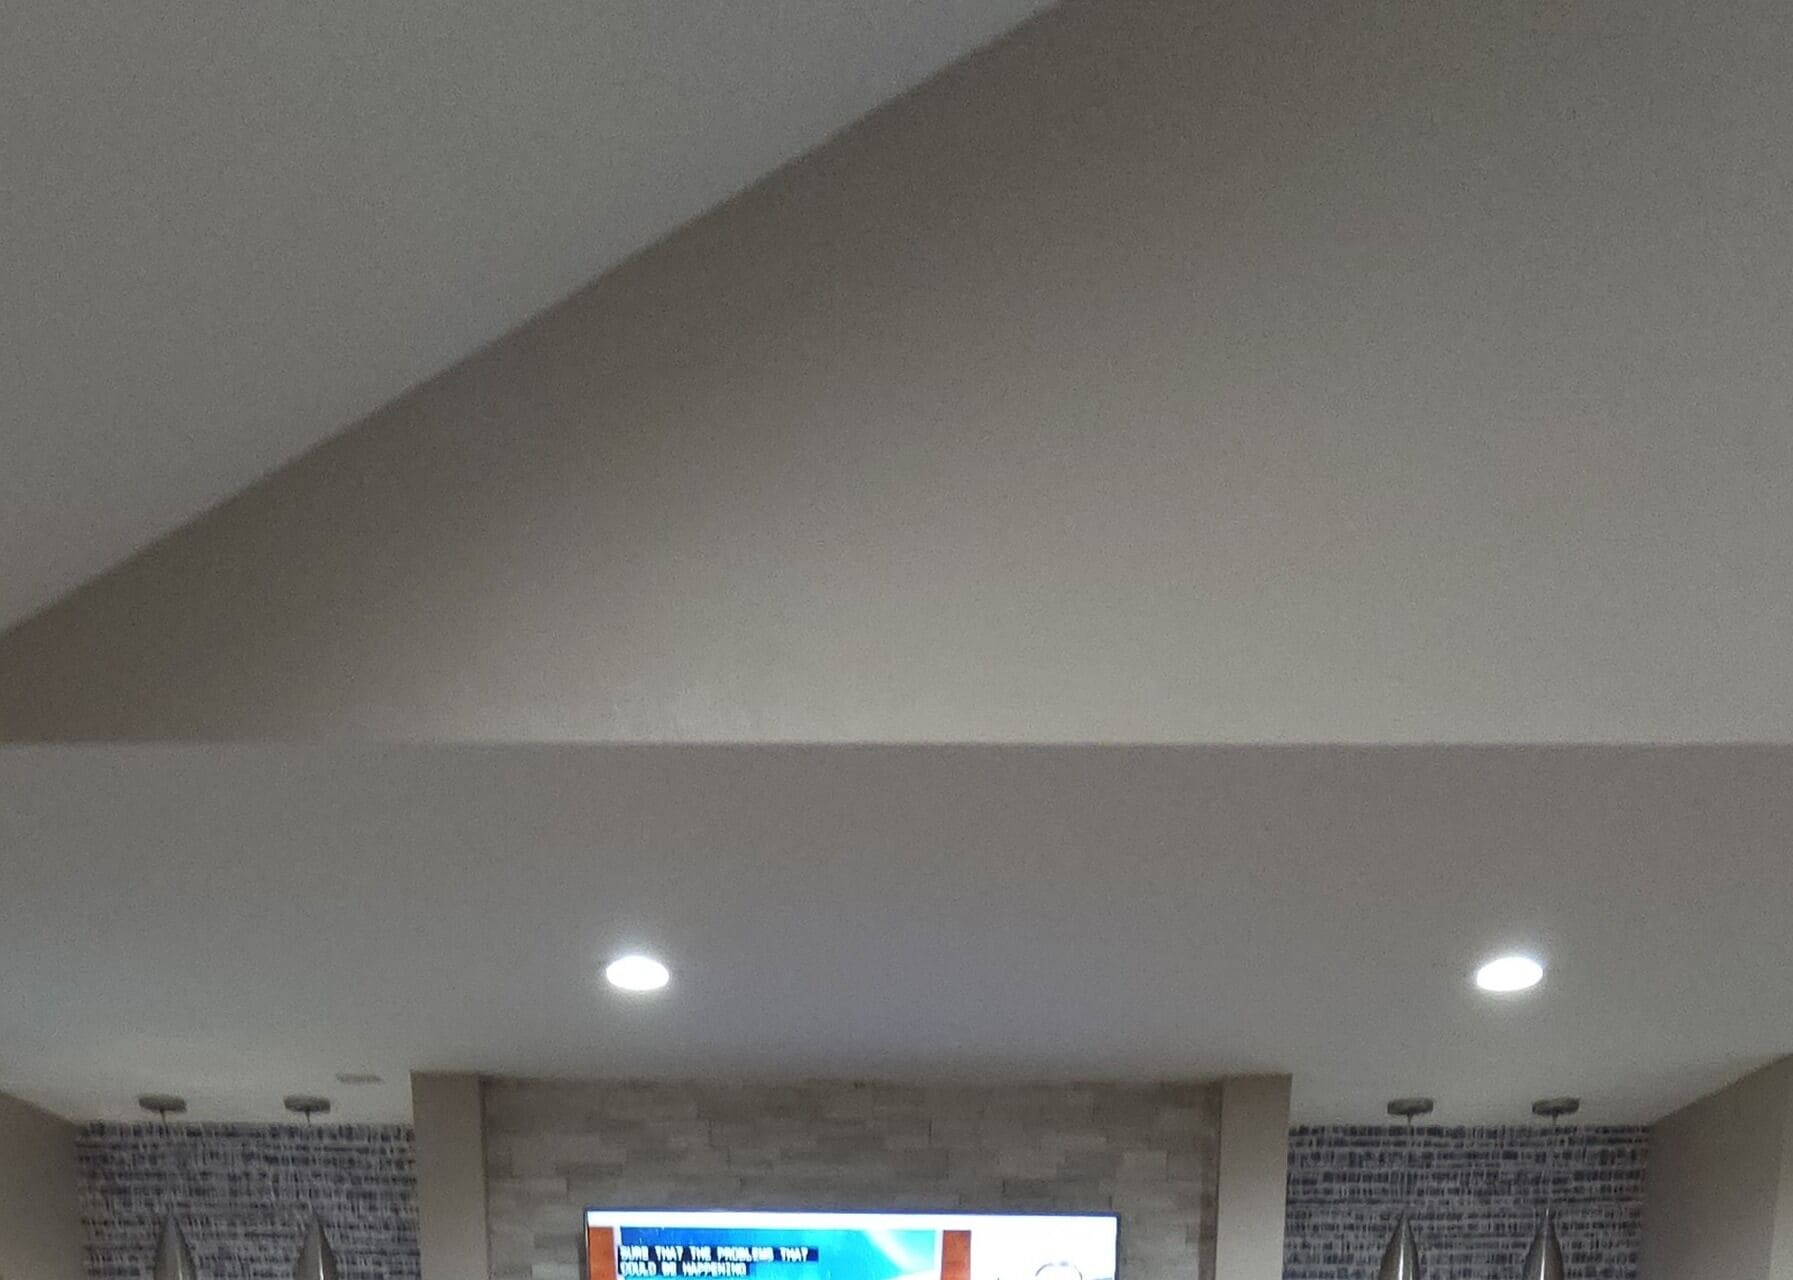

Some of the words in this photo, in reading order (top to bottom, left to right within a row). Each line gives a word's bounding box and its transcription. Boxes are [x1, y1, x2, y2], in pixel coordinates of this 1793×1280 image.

[620, 1245, 648, 1261] SURE
[655, 1245, 684, 1261] THAT
[690, 1246, 711, 1262] THE
[717, 1246, 774, 1262] PROBLEMS
[780, 1247, 808, 1262] THAT
[620, 1261, 657, 1276] COULD
[661, 1261, 677, 1276] BE
[682, 1262, 747, 1277] HAPPENING
